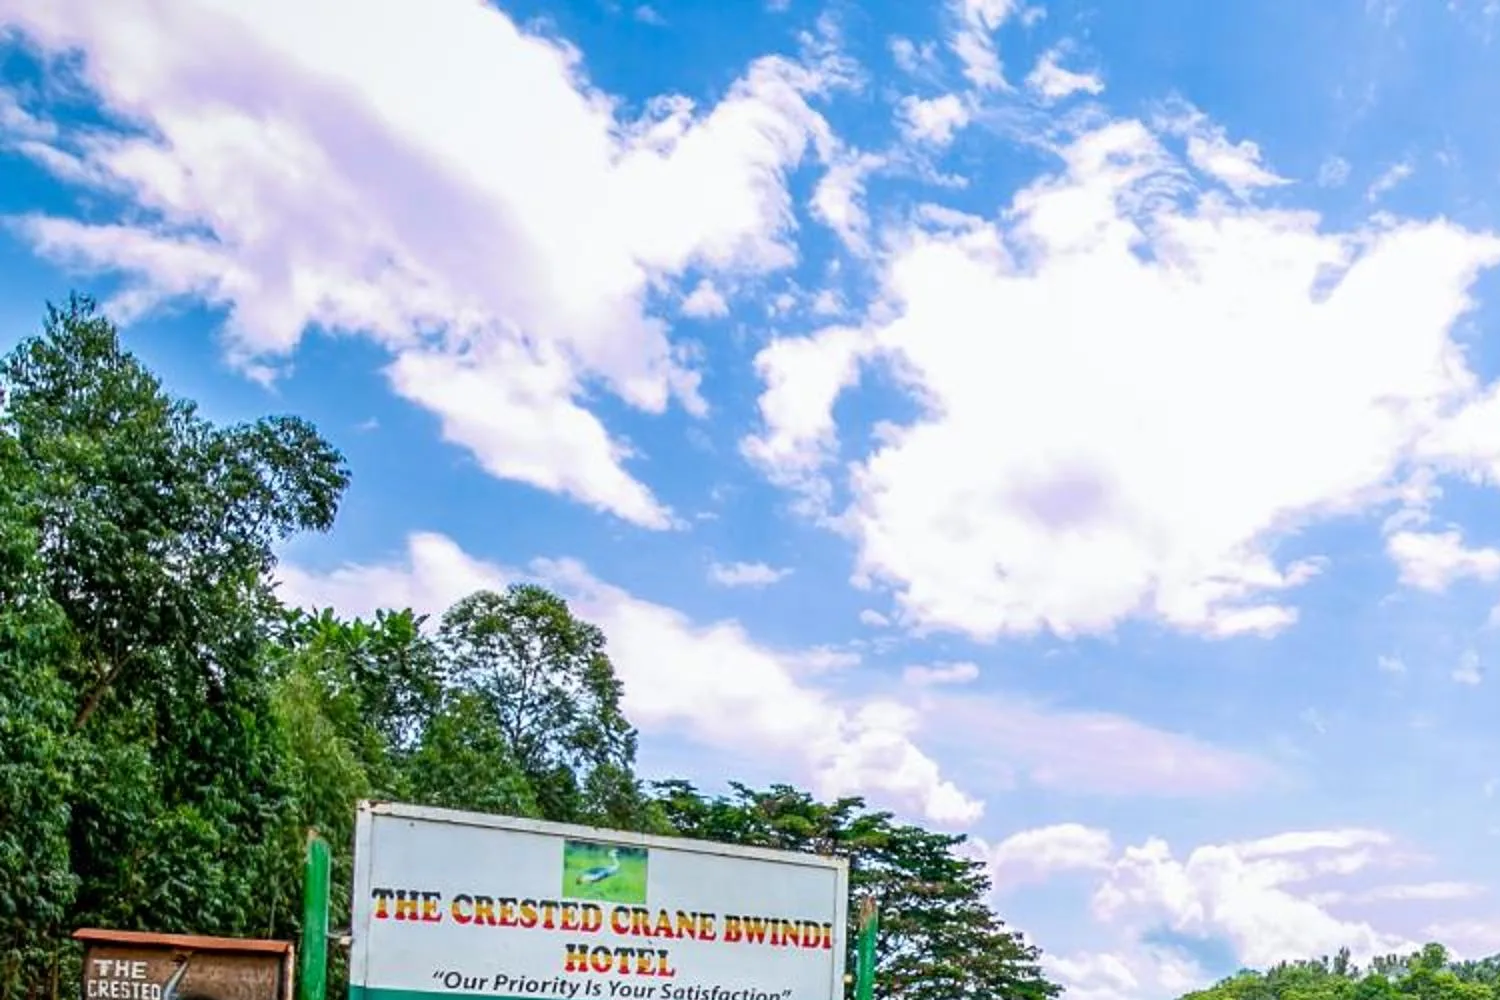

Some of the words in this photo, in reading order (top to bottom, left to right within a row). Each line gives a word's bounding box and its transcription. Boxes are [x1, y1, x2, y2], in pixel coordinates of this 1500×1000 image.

[372, 888, 442, 922] THE
[451, 894, 602, 932] CRESTED
[611, 905, 716, 941] CRANE
[724, 915, 832, 949] BWINDI
[94, 960, 147, 979] THE
[565, 944, 675, 976] HOTEL
[88, 979, 161, 1000] CRESTED
[494, 974, 580, 998] Priority
[585, 979, 602, 996] Is
[608, 981, 655, 999] Your
